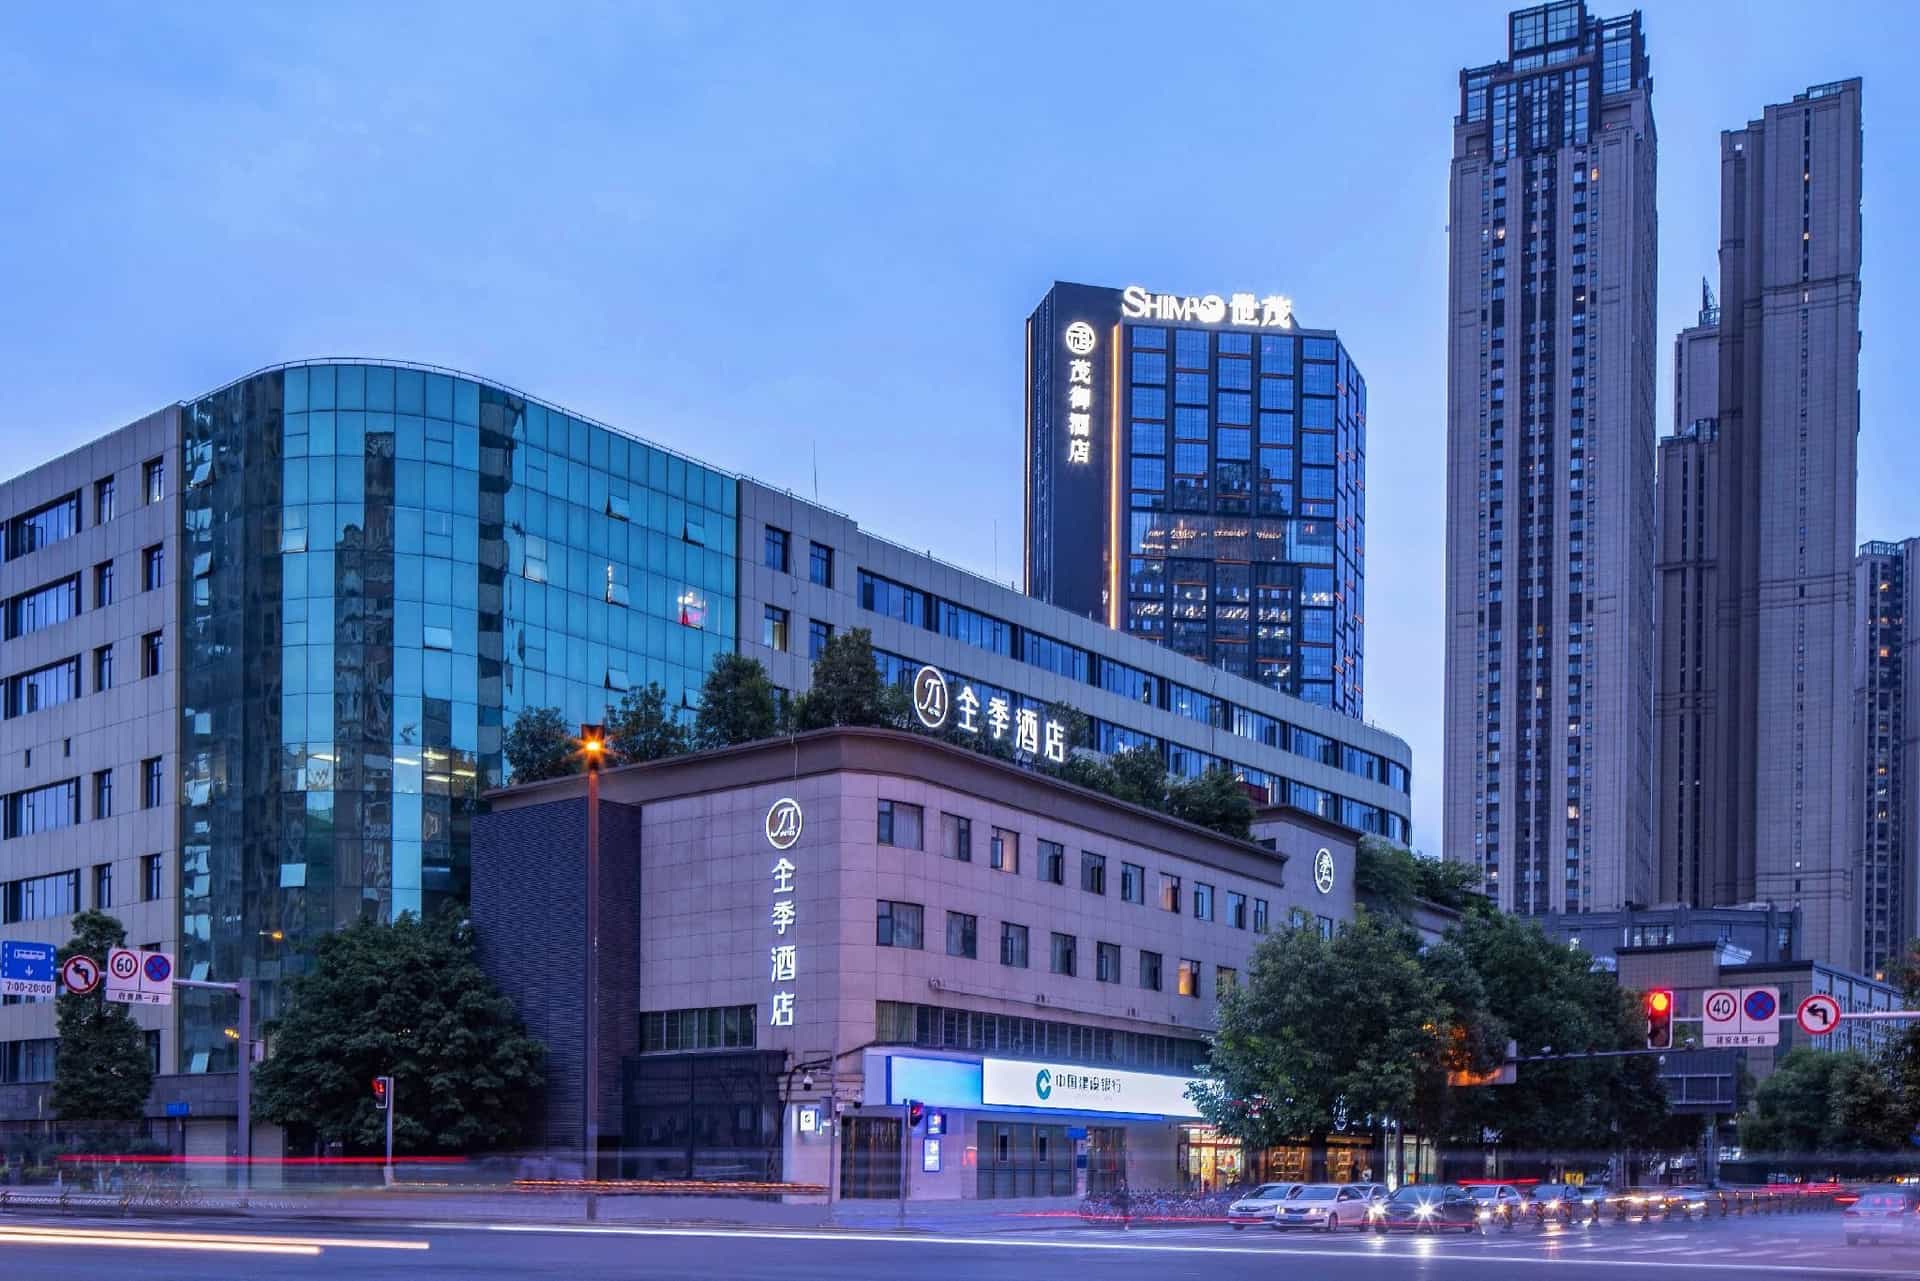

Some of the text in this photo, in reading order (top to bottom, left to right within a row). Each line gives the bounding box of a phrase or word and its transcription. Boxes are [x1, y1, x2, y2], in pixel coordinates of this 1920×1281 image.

[1230, 293, 1292, 328] 世茂
[956, 686, 1065, 763] 全季酒店
[770, 858, 796, 1027] 全季酒店
[116, 957, 133, 973] 60
[1713, 999, 1730, 1015] 40
[1055, 1073, 1121, 1093] 中国建设银行
